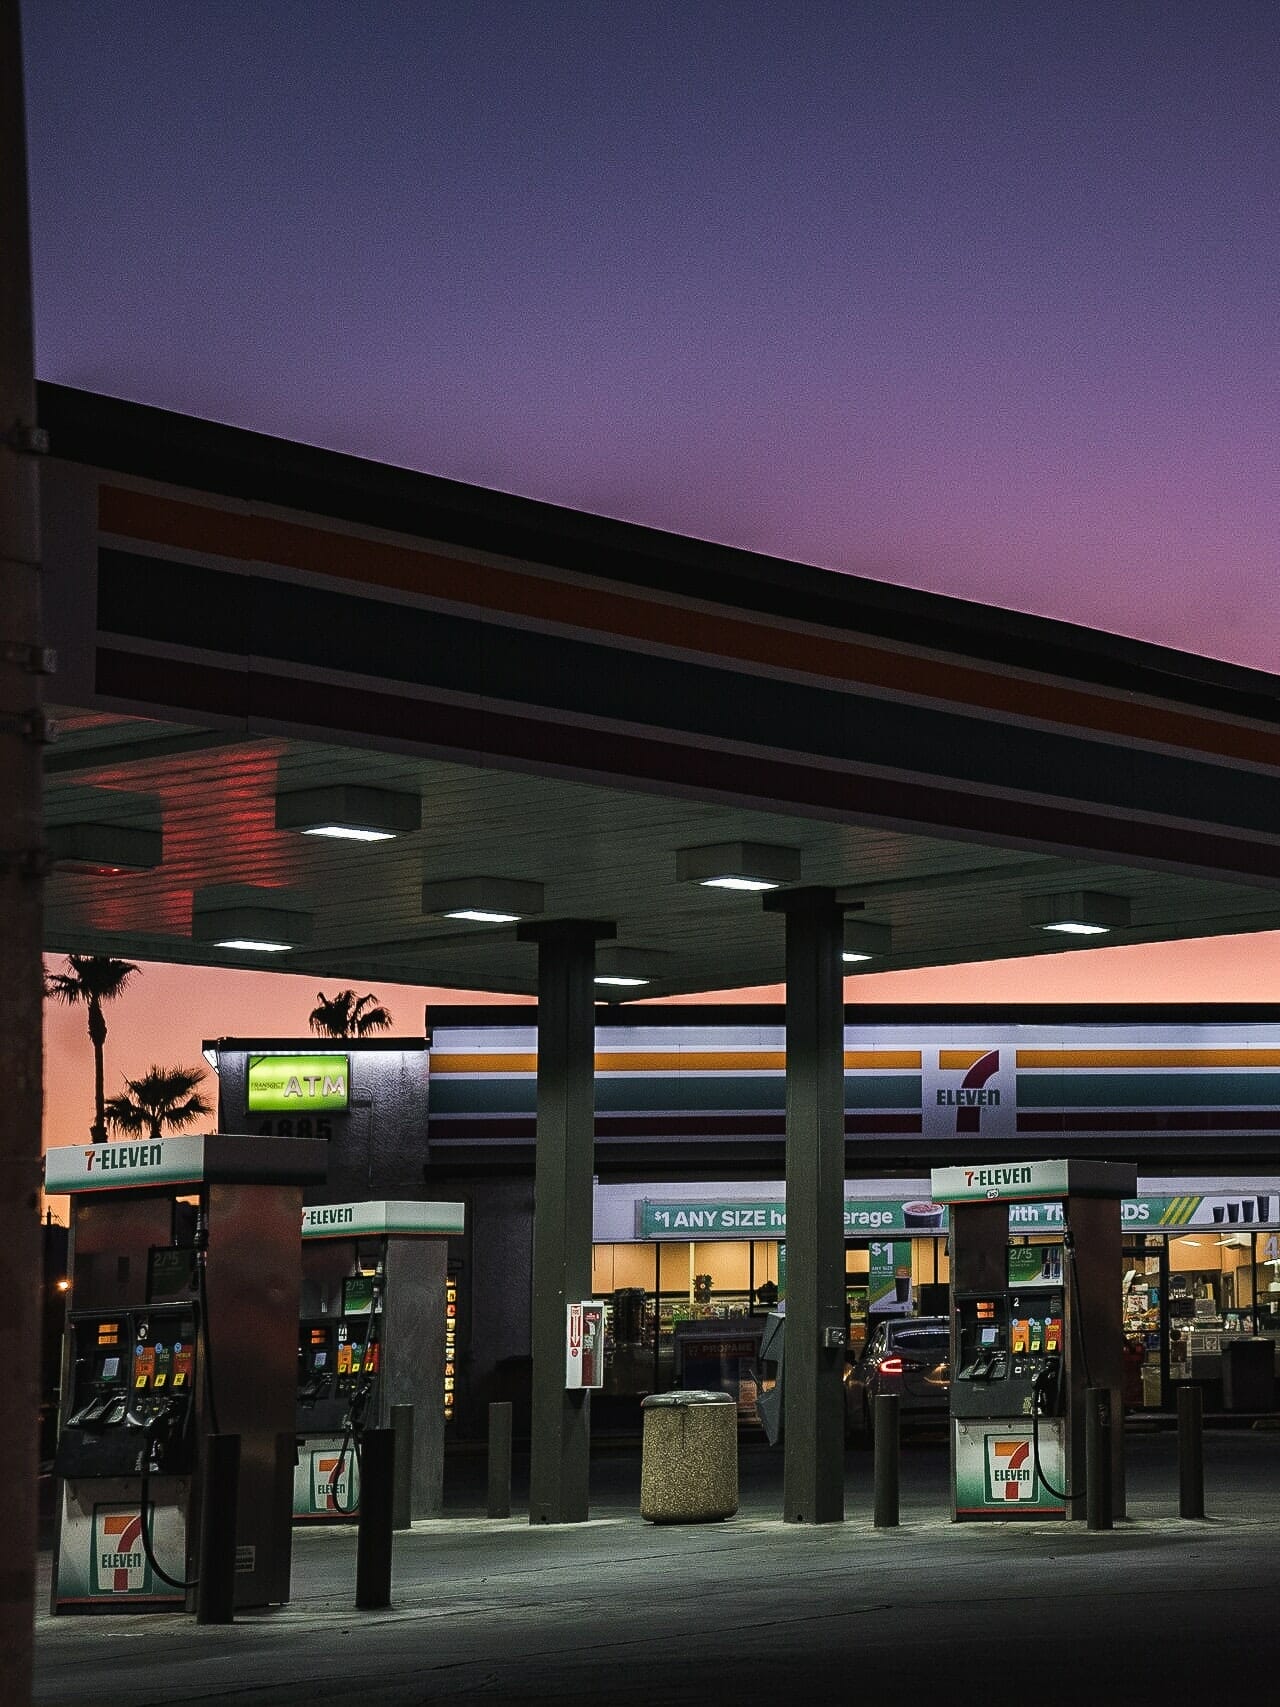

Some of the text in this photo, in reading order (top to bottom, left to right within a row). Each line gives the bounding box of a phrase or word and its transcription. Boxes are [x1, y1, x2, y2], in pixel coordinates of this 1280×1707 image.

[284, 1076, 346, 1097] ATM
[654, 1210, 670, 1228] $1
[673, 1211, 718, 1228] ANY
[721, 1210, 766, 1227] SIZE
[844, 1211, 893, 1228] erage
[871, 1242, 894, 1265] $1
[995, 1441, 1030, 1500] 7
